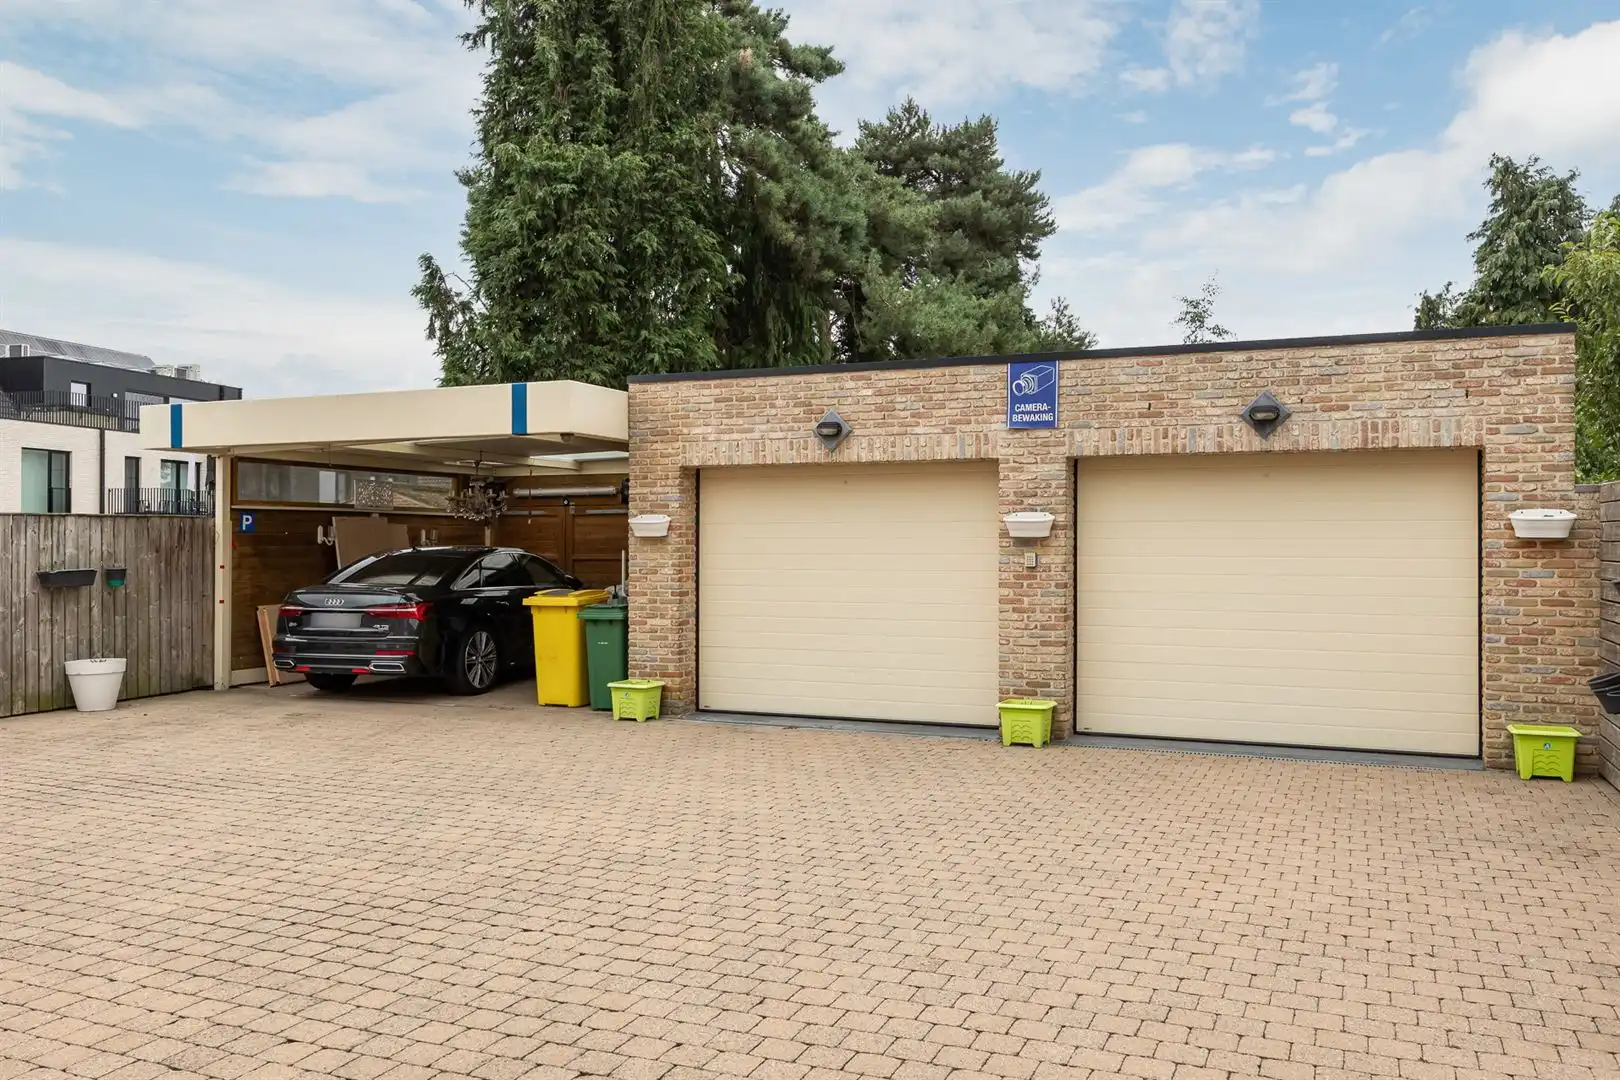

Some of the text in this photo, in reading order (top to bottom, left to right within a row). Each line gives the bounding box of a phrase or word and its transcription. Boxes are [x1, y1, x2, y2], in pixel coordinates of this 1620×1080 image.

[1014, 403, 1052, 412] CAMERA-
[1012, 413, 1054, 422] BEWAKING
[242, 515, 252, 530] P
